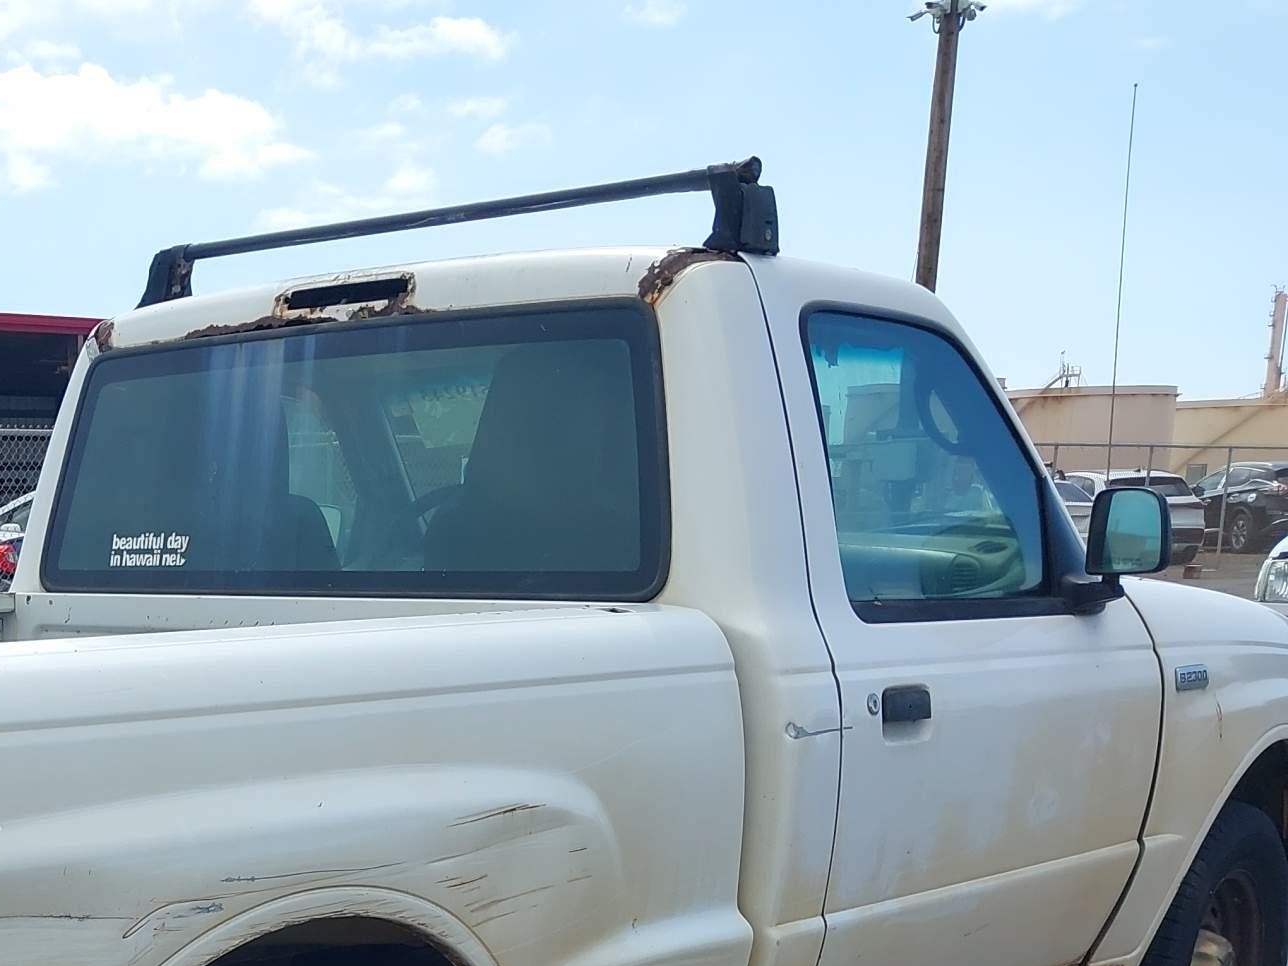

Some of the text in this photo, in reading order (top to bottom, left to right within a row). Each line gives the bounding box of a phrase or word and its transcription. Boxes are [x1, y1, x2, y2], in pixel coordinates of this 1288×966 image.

[112, 532, 189, 552] beautiful day
[110, 551, 121, 566] in
[121, 549, 161, 566] hawaii
